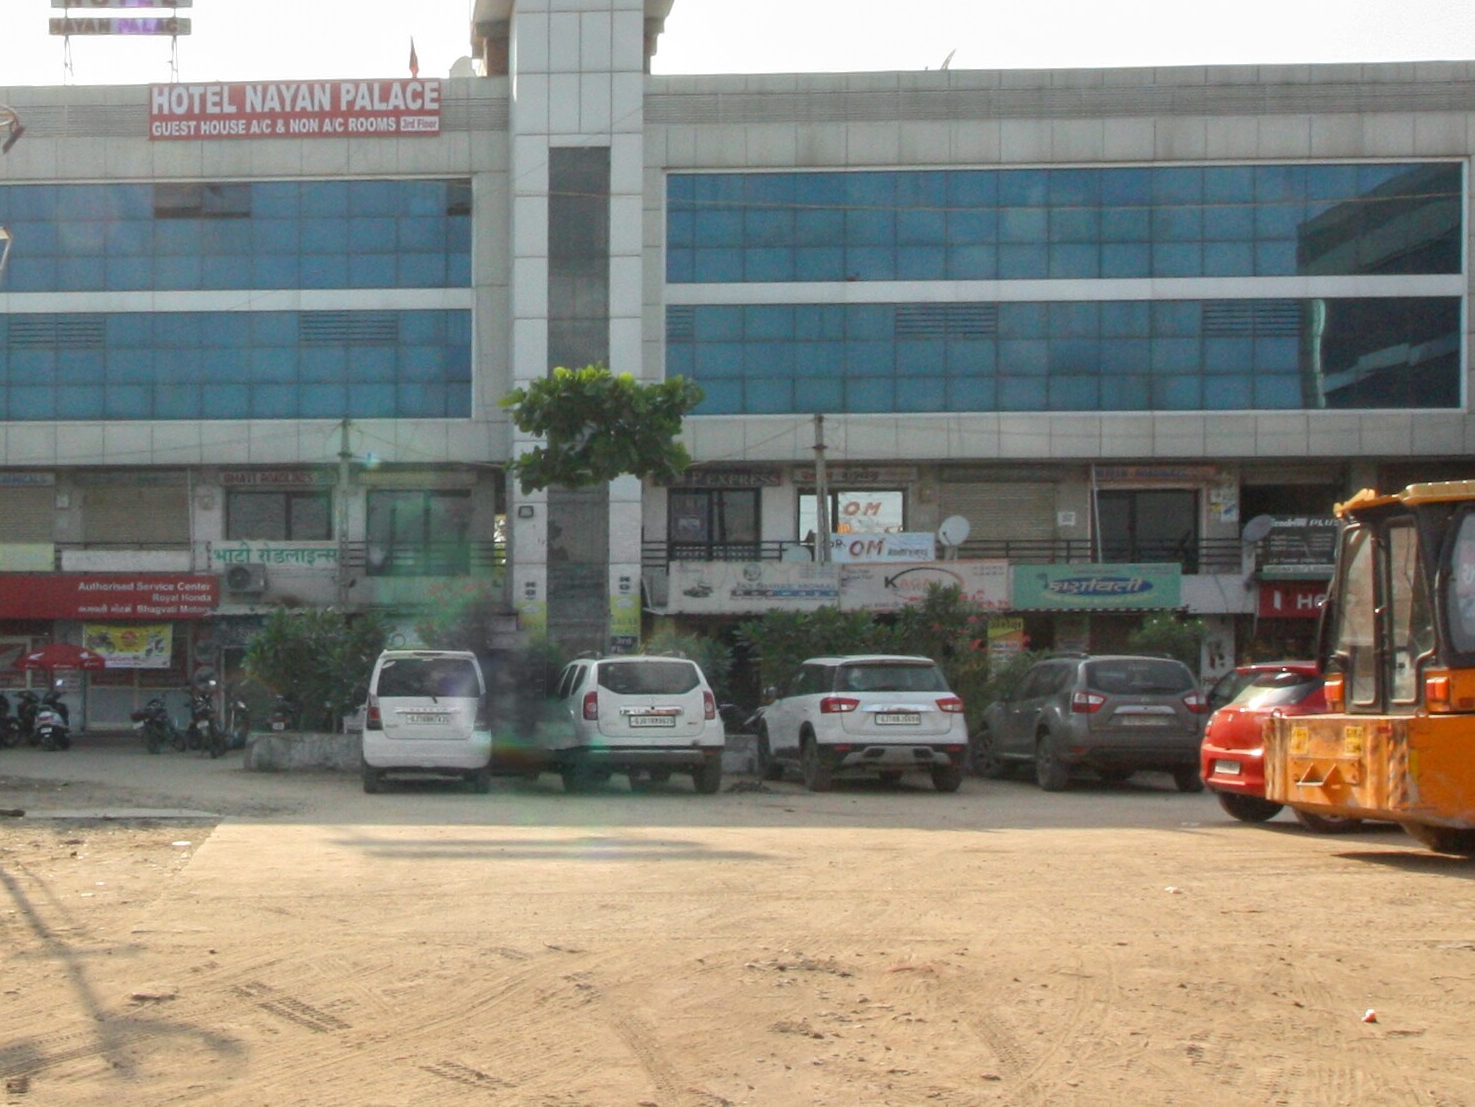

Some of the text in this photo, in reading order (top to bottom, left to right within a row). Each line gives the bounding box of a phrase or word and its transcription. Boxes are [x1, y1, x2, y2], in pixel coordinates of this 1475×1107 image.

[152, 81, 440, 115] HOTEL NAYAN PALACE
[152, 122, 197, 136] GUEST
[200, 120, 246, 135] HOUSE
[250, 119, 272, 134] A/C
[276, 119, 286, 133] &
[290, 118, 319, 133] NON
[322, 117, 344, 132] A/C
[348, 116, 396, 131] ROOMS
[843, 500, 882, 516] OM
[849, 538, 887, 557] OM
[78, 581, 212, 592] Authorised Service Center
[152, 593, 212, 604] Royal Honda
